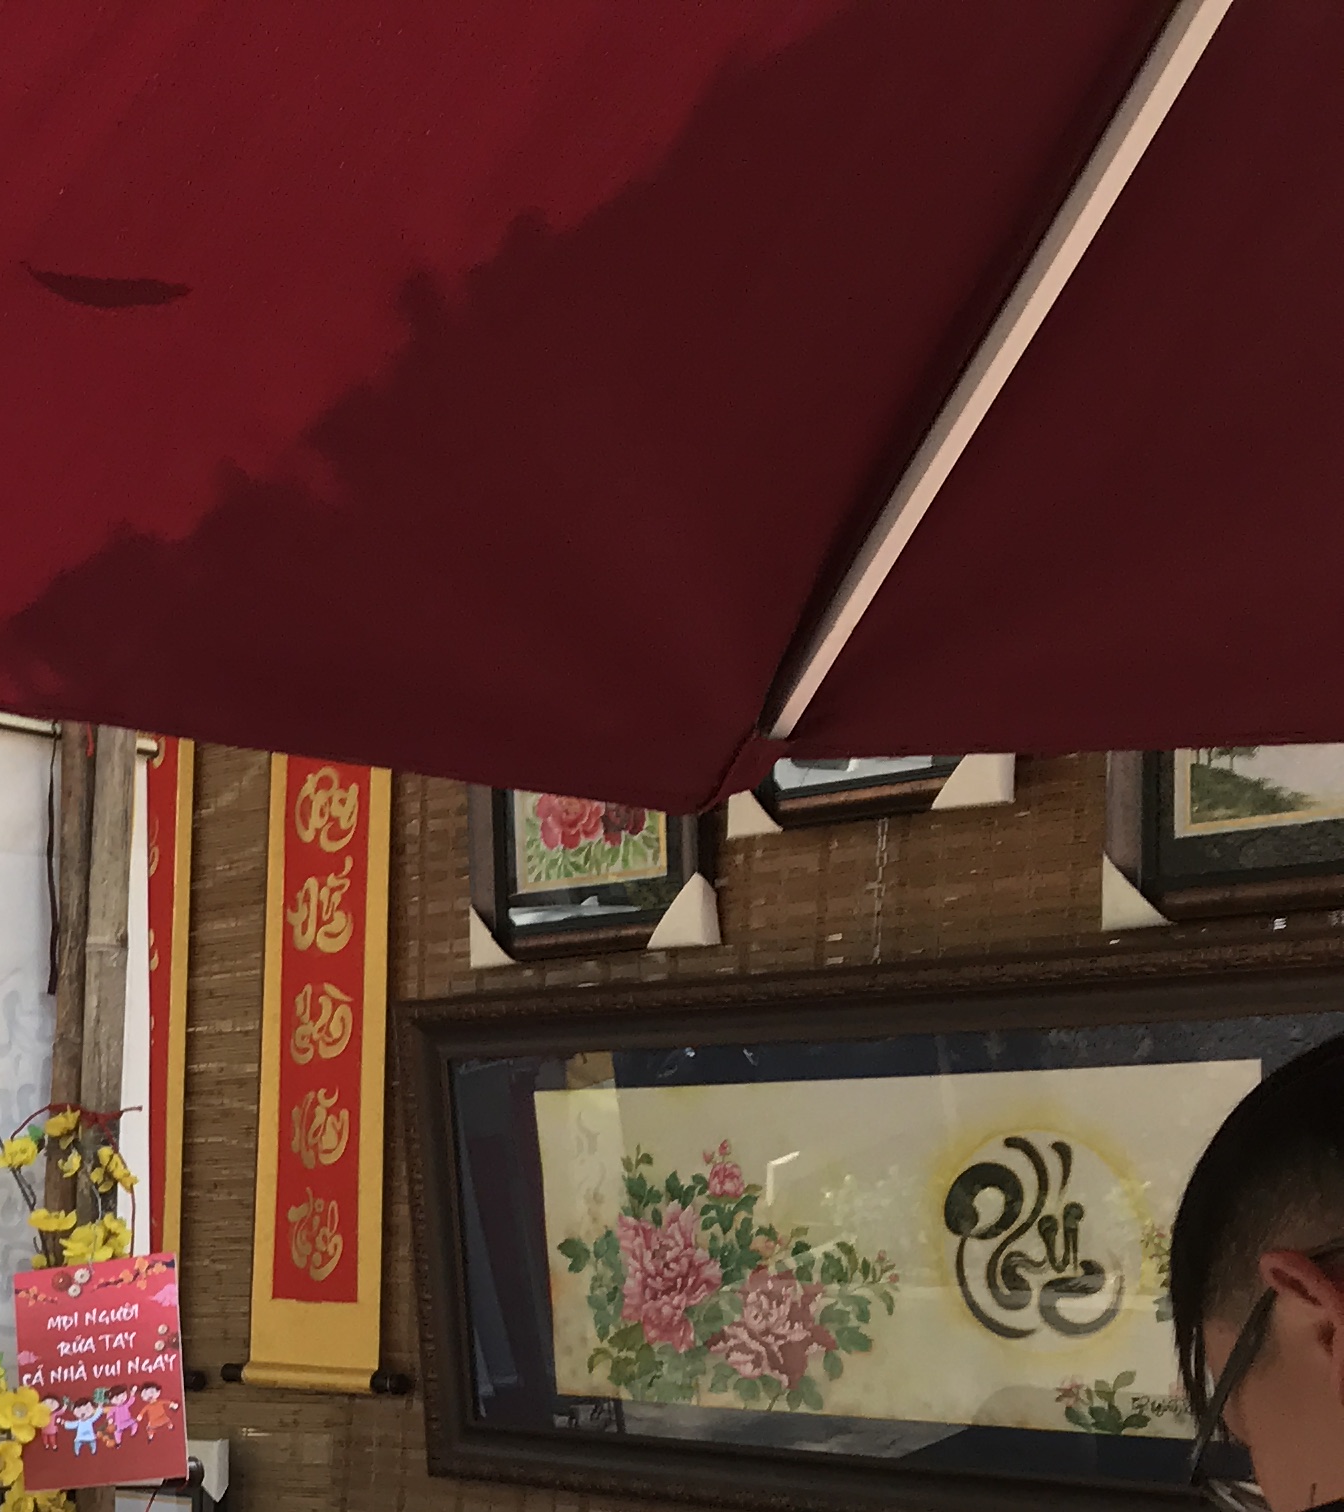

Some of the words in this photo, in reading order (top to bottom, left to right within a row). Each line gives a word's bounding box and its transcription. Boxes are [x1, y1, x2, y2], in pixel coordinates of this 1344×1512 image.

[98, 1331, 137, 1352] TAY
[50, 1359, 88, 1385] NHÀ
[92, 1359, 122, 1379] VUI
[127, 1353, 177, 1375] NGAY
